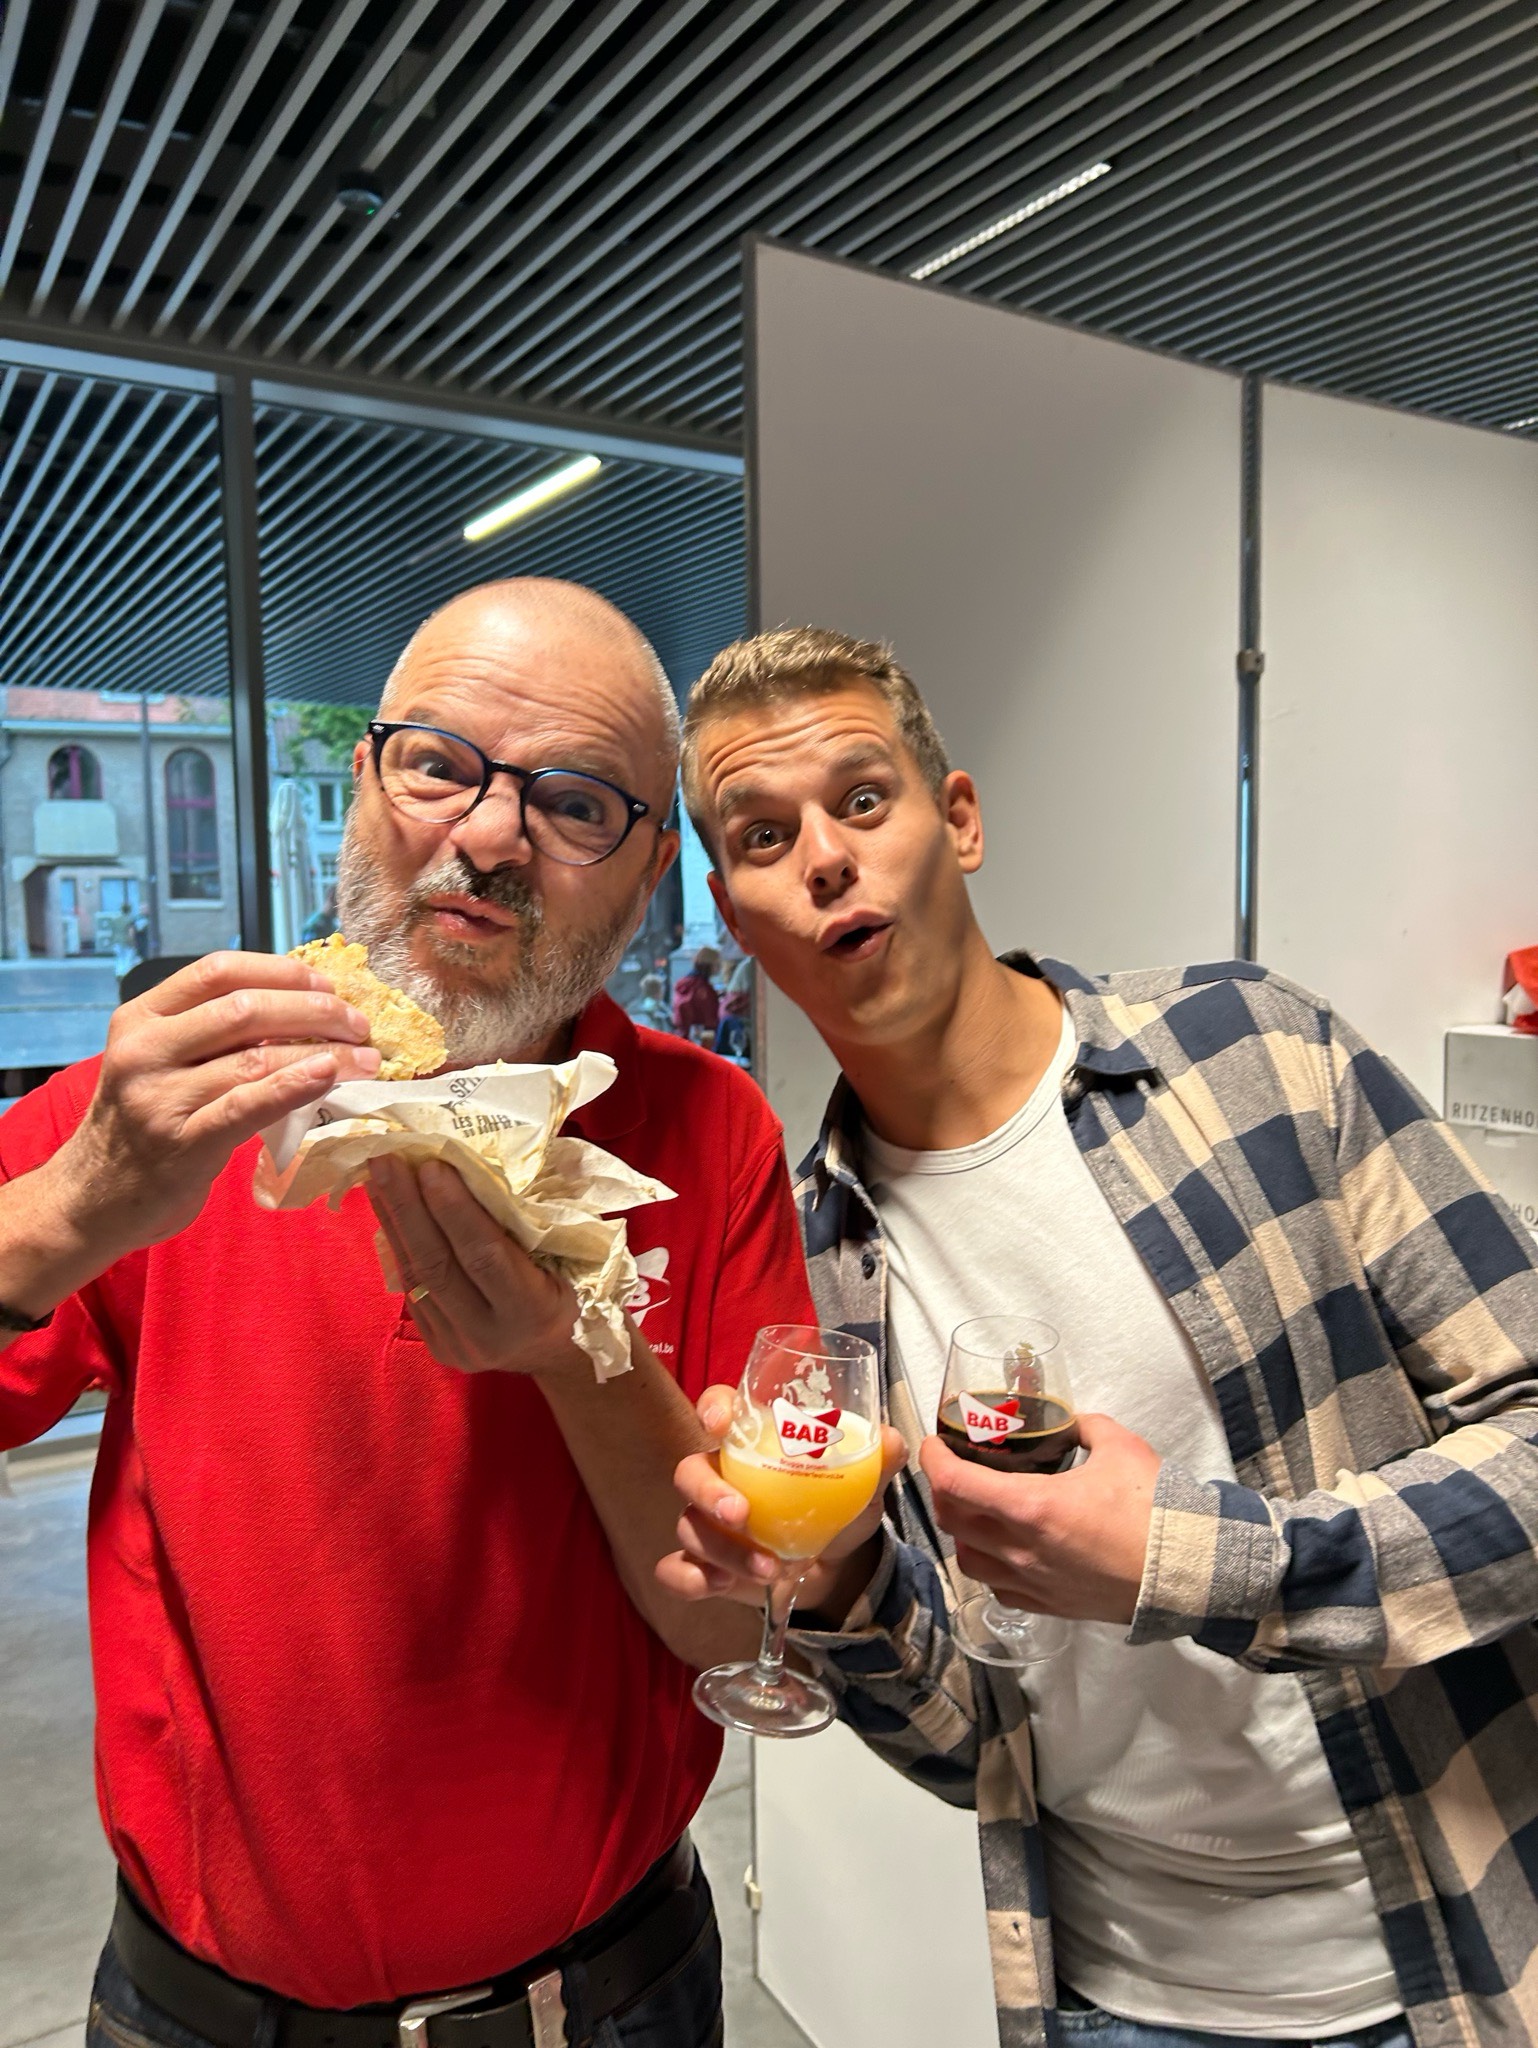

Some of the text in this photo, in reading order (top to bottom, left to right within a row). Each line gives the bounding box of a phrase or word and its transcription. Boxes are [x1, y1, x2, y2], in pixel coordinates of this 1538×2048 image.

[452, 1115, 473, 1130] LES
[1452, 1102, 1538, 1127] RITZENHO
[781, 1420, 828, 1443] BAB
[967, 1411, 1009, 1431] BAB
